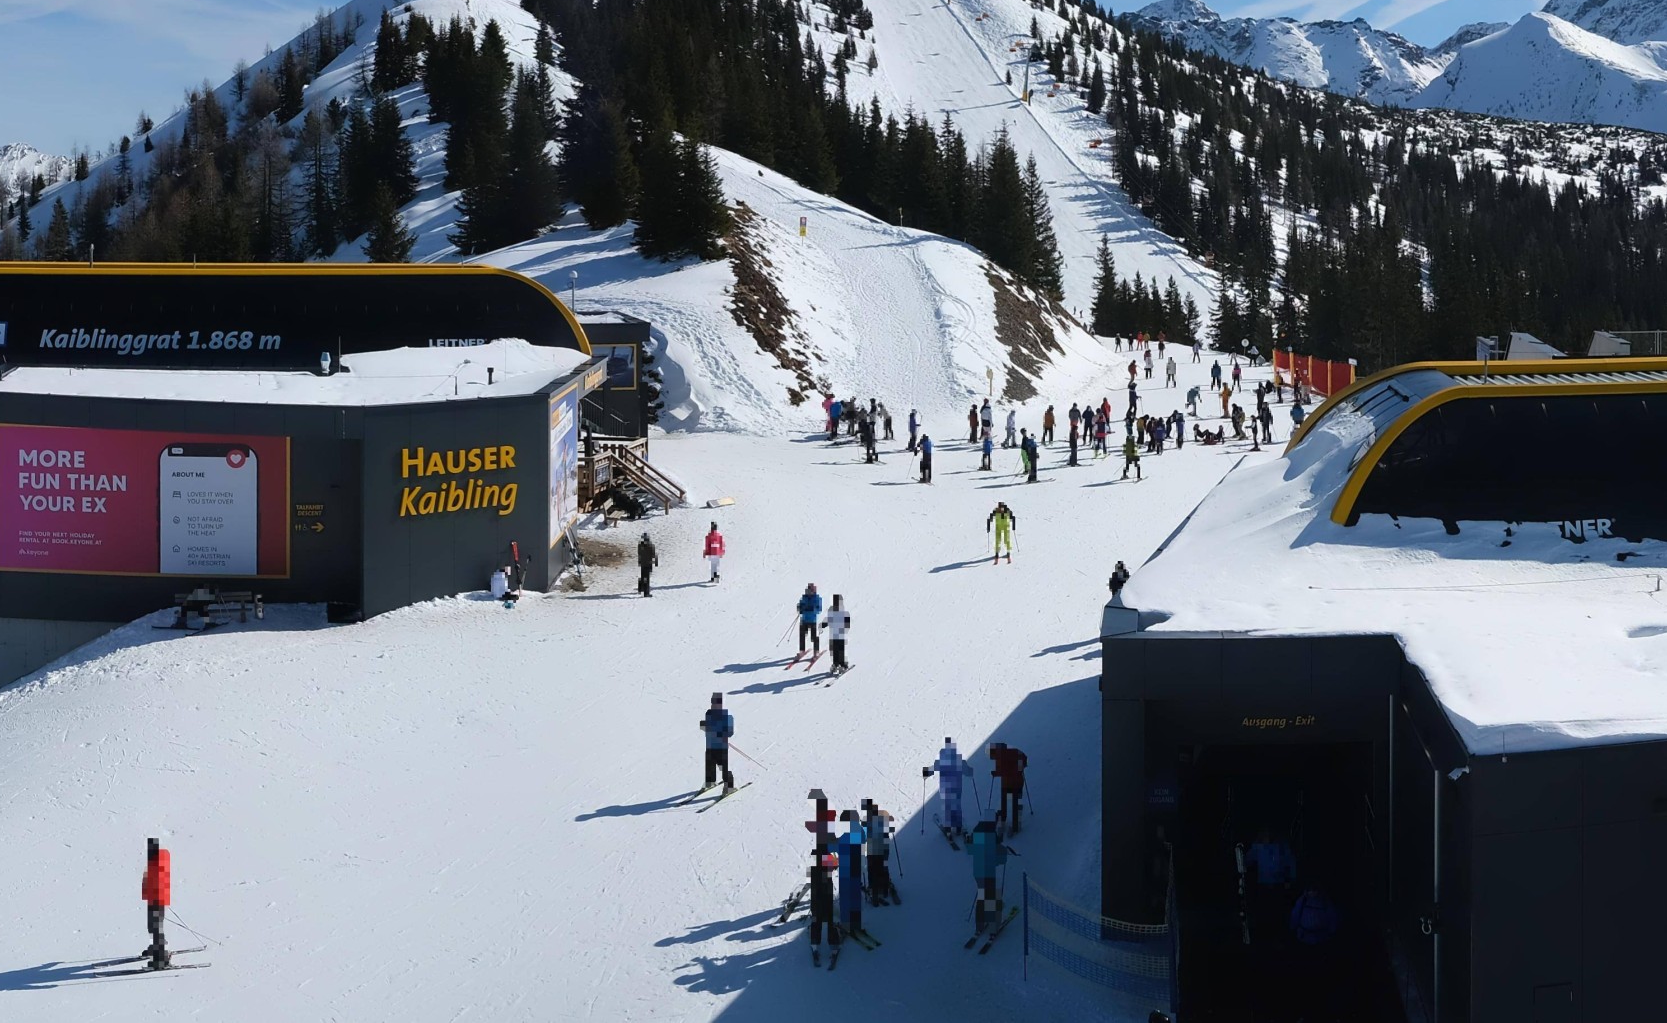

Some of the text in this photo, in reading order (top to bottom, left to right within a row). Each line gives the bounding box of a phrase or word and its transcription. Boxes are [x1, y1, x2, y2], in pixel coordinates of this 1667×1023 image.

[40, 328, 282, 355] Kaiblinggrat 1.868 m
[428, 338, 485, 347] LEITNER
[18, 449, 86, 468] MORE
[402, 445, 516, 478] HAUSER
[18, 472, 127, 492] FUN THAN
[19, 495, 107, 513] YOUR EX
[400, 479, 518, 517] Kaibling
[1242, 716, 1287, 729] Ausgang
[1295, 715, 1315, 726] Exit
